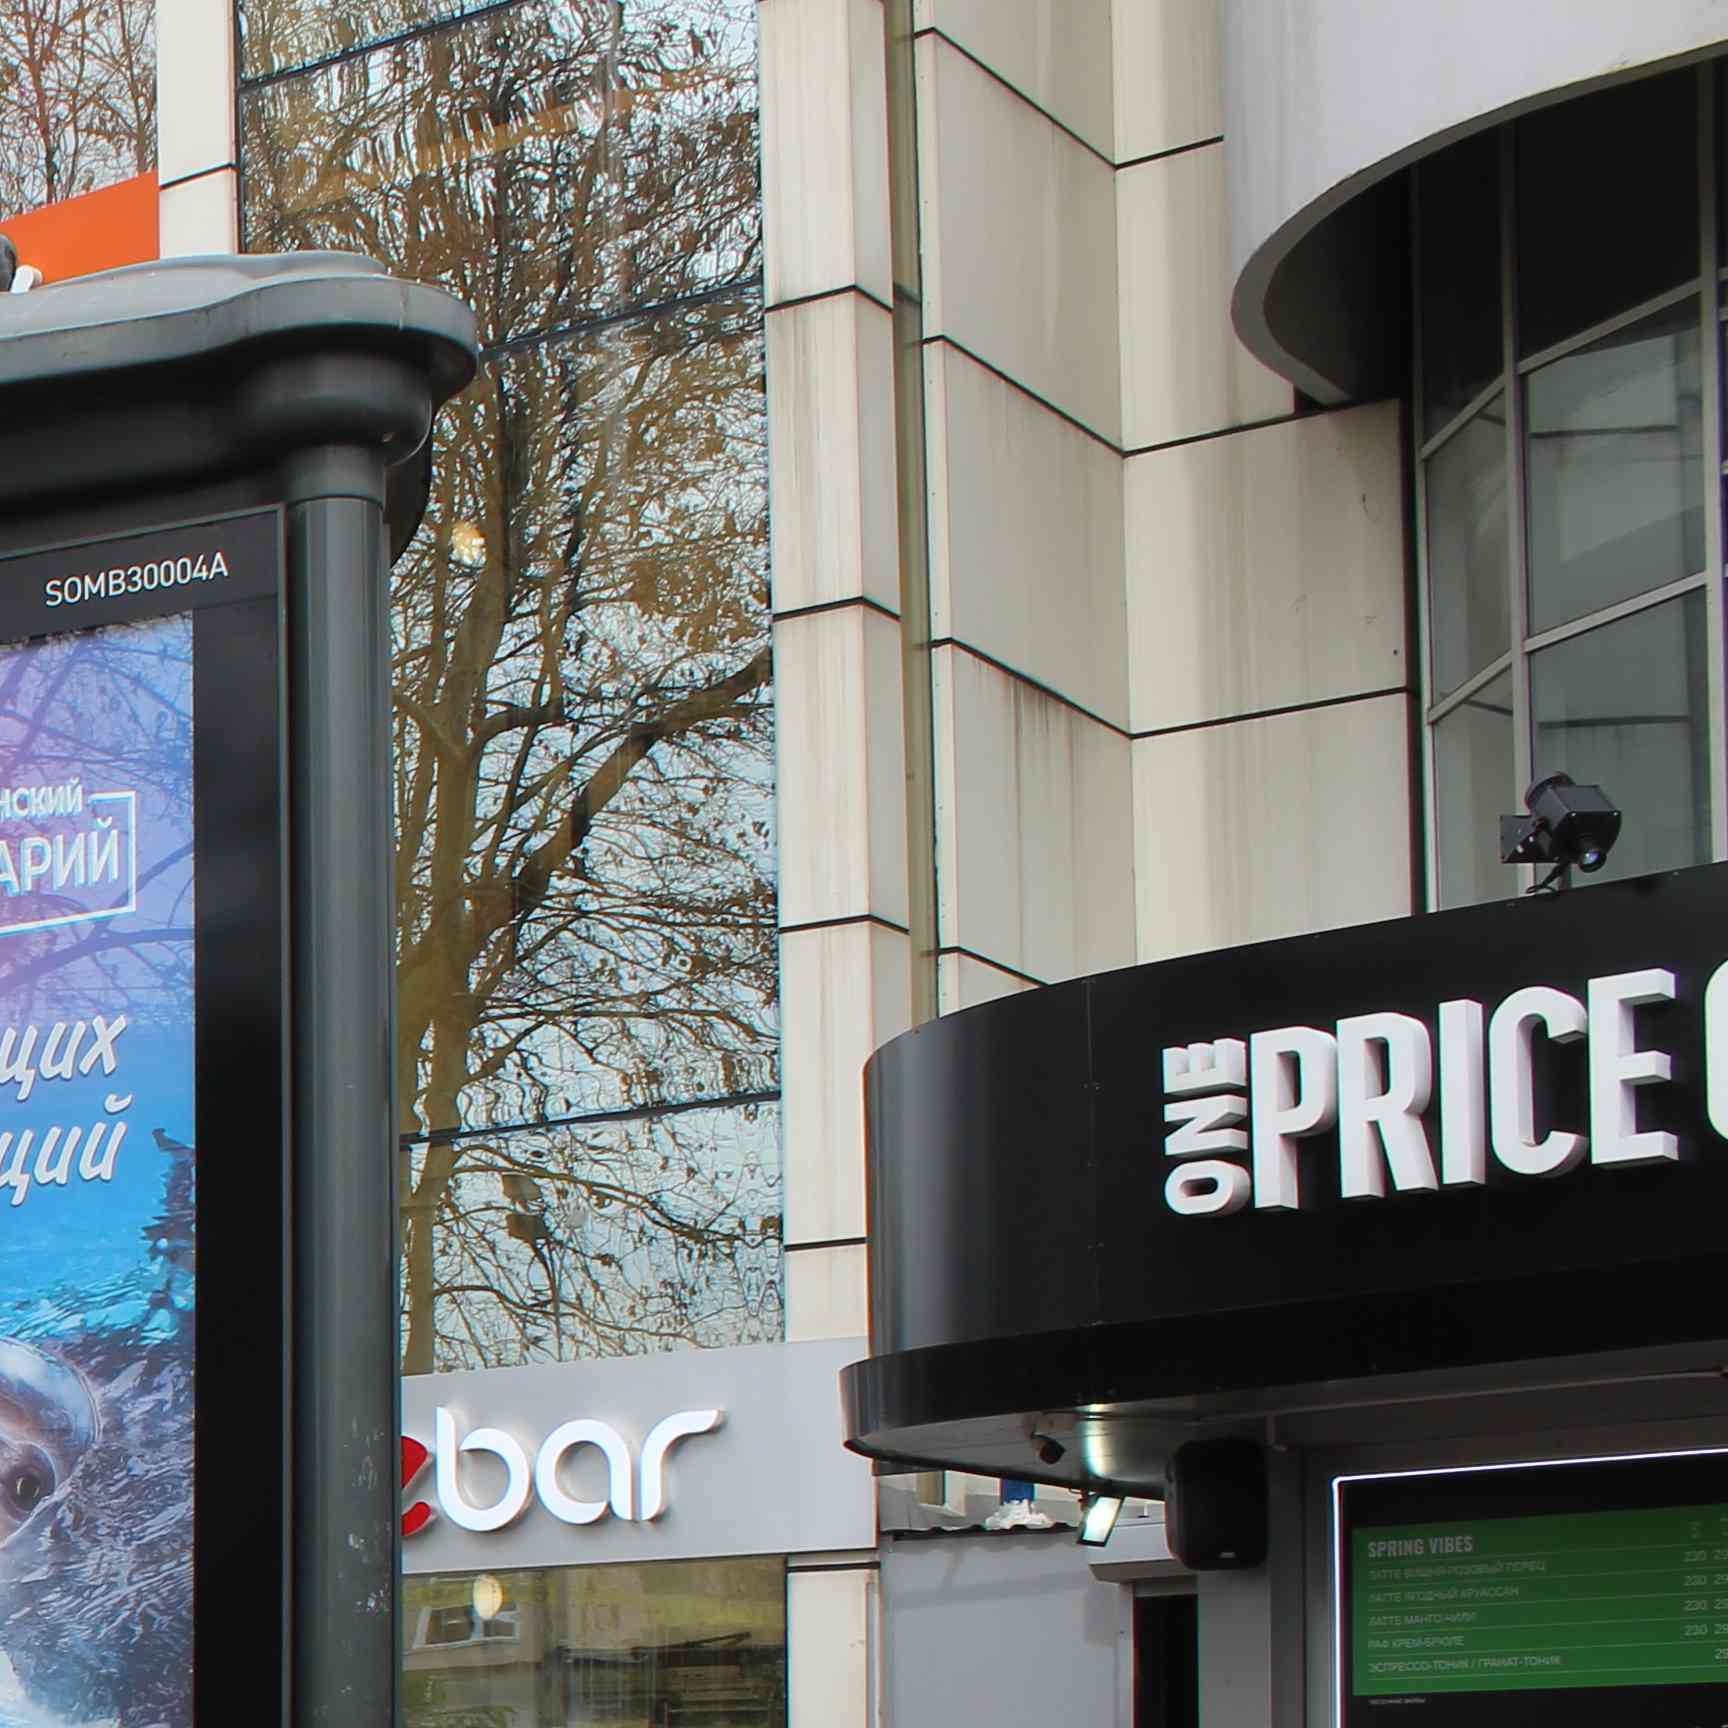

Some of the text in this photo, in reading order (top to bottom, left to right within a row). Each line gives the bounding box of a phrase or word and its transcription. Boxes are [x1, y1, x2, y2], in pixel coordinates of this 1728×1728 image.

[44, 551, 229, 607] SOMB30004A
[1163, 1036, 1249, 1217] ONE
[1249, 967, 1680, 1210] PRICE
[1368, 1536, 1474, 1559] SPRING VIBES
